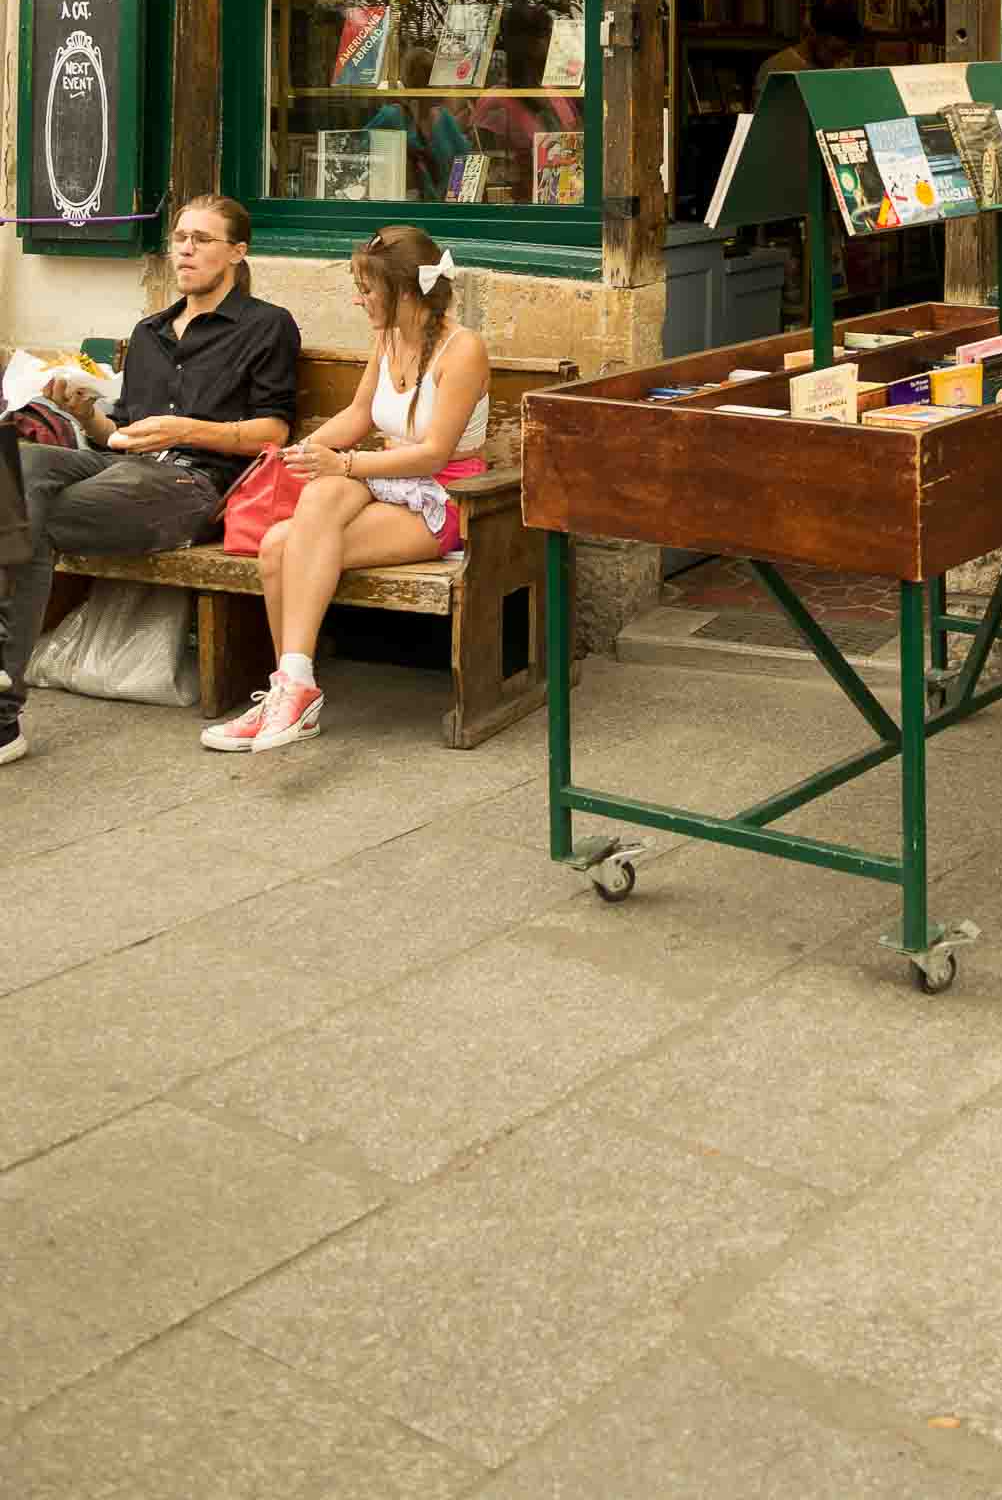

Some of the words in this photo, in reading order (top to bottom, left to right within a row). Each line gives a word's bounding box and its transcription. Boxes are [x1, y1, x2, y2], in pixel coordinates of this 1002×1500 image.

[339, 11, 383, 67] AMERICANS
[351, 28, 384, 67] ABROAD
[64, 60, 91, 76] NEXT
[62, 75, 95, 92] EVENT
